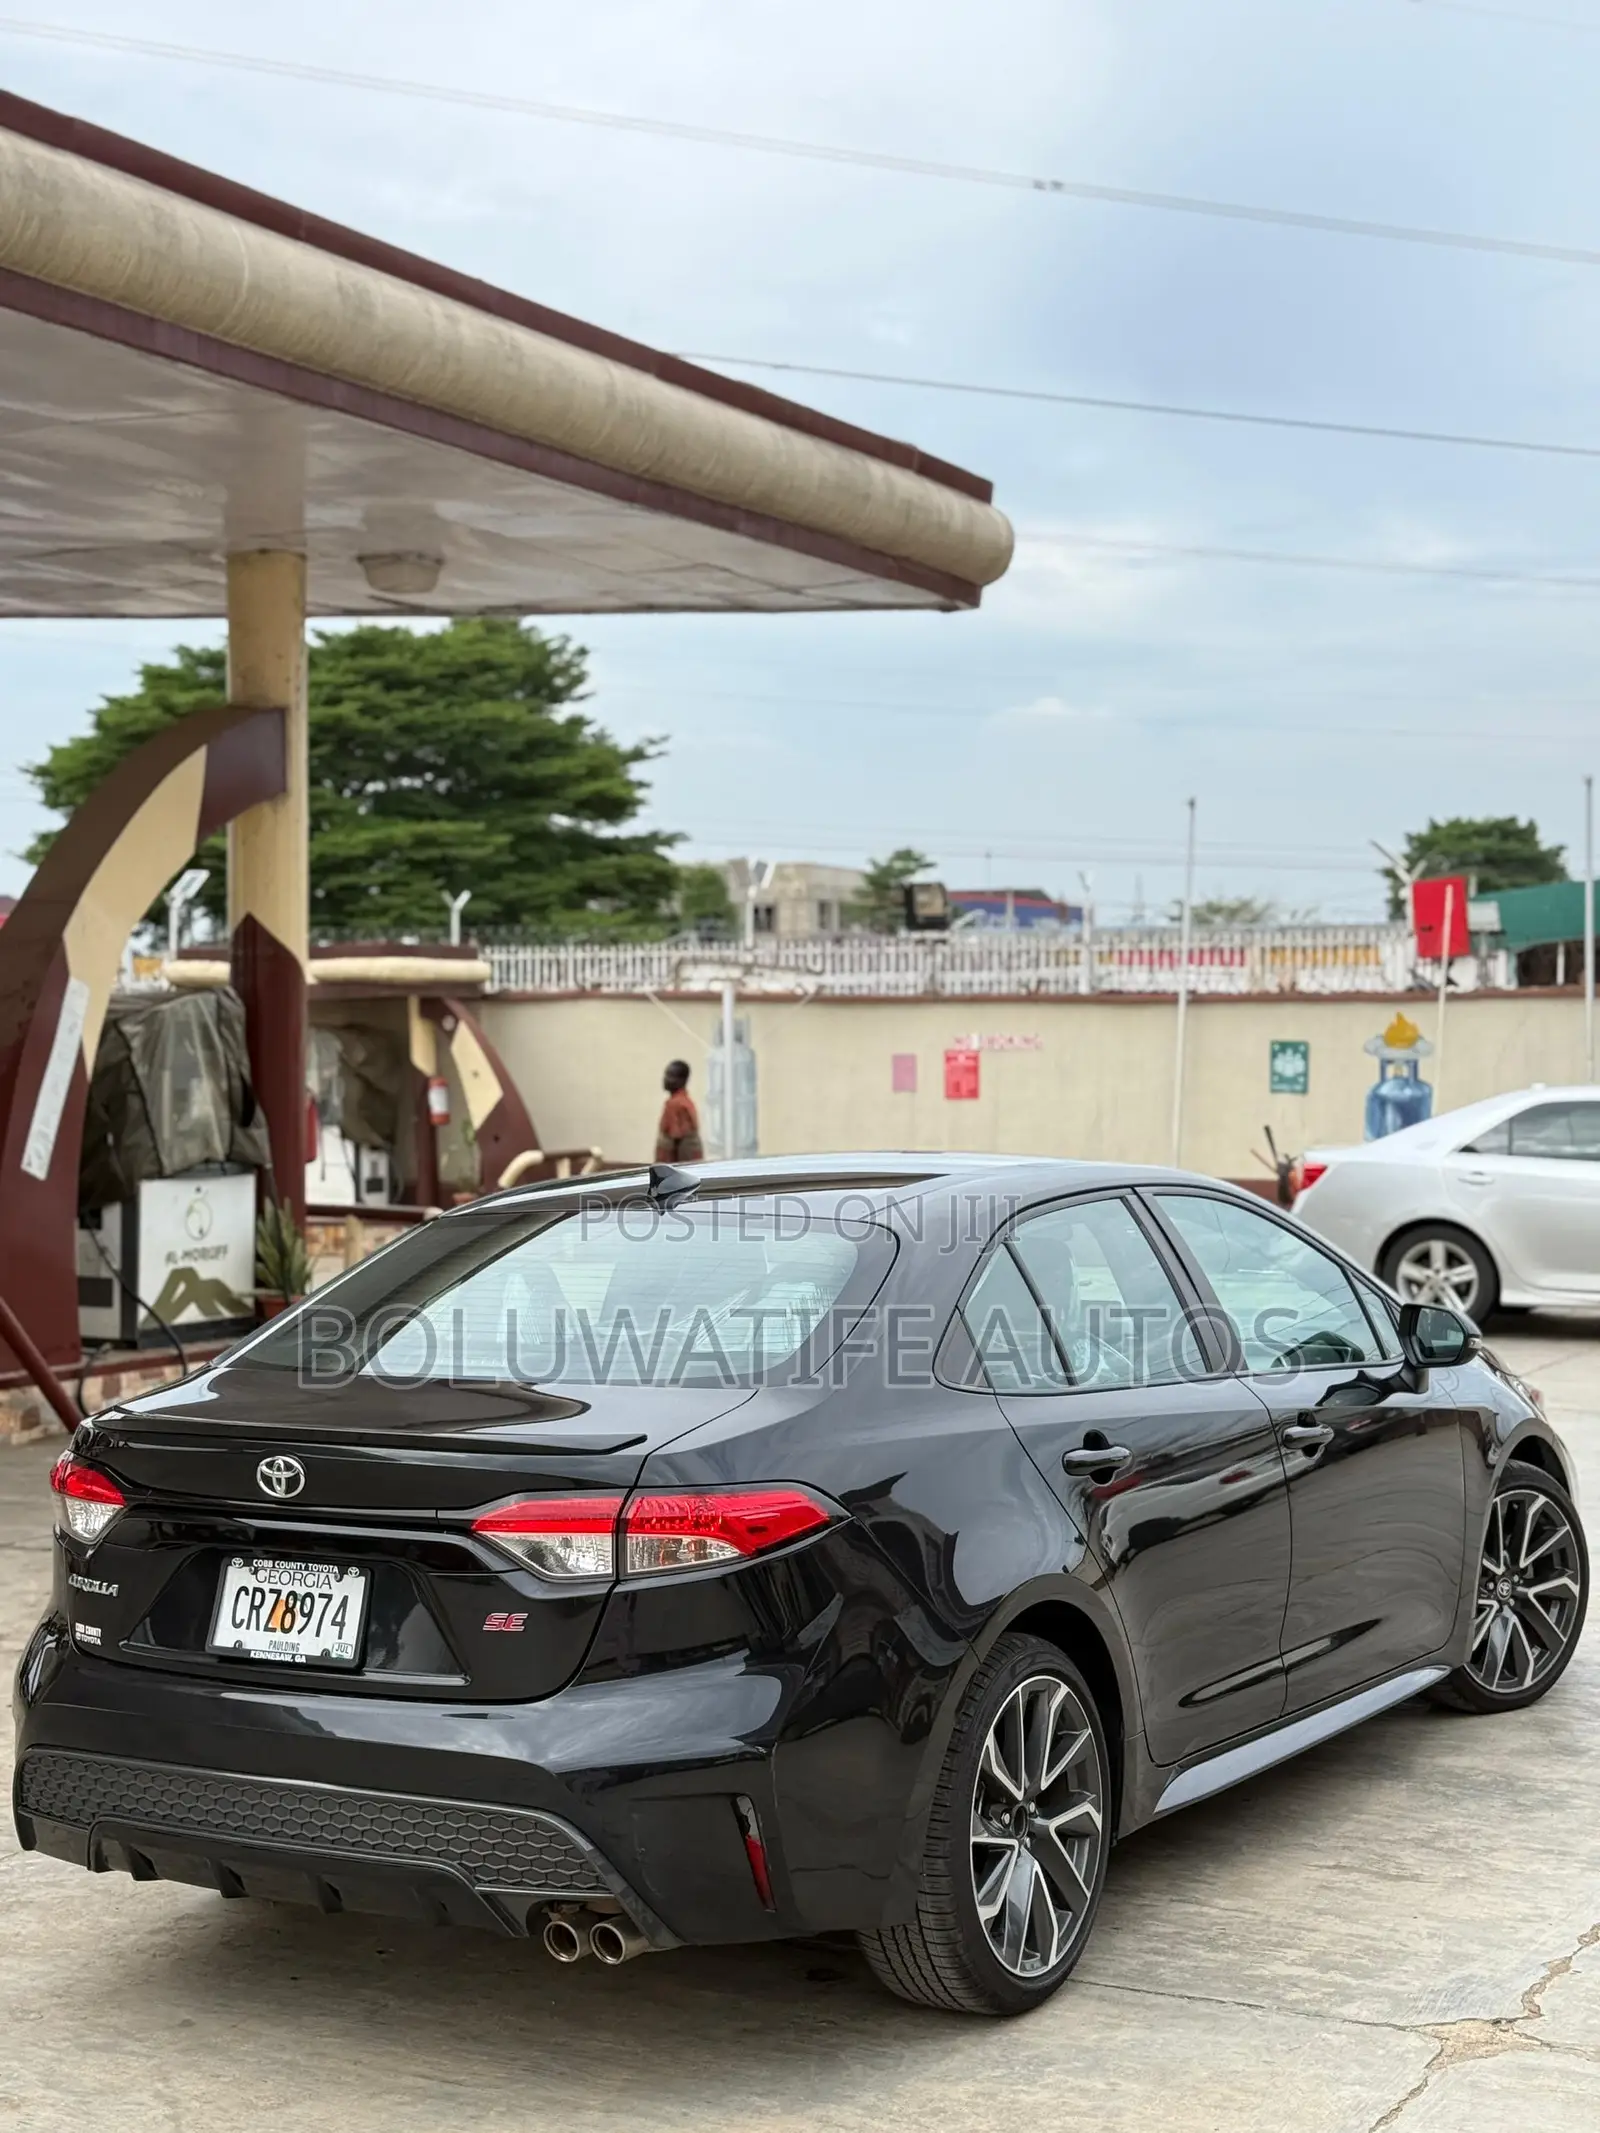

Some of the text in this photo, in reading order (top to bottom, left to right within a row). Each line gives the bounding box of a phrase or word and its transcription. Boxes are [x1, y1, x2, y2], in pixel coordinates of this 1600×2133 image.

[252, 1559, 339, 1574] COBB COUNTY TOYOTA
[255, 1568, 332, 1590] GEORGIA
[231, 1585, 349, 1640] CRZ8974
[482, 1612, 529, 1631] SE
[268, 1640, 301, 1652] PAULDING
[335, 1643, 349, 1655] JUL
[294, 1654, 307, 1664] GA
